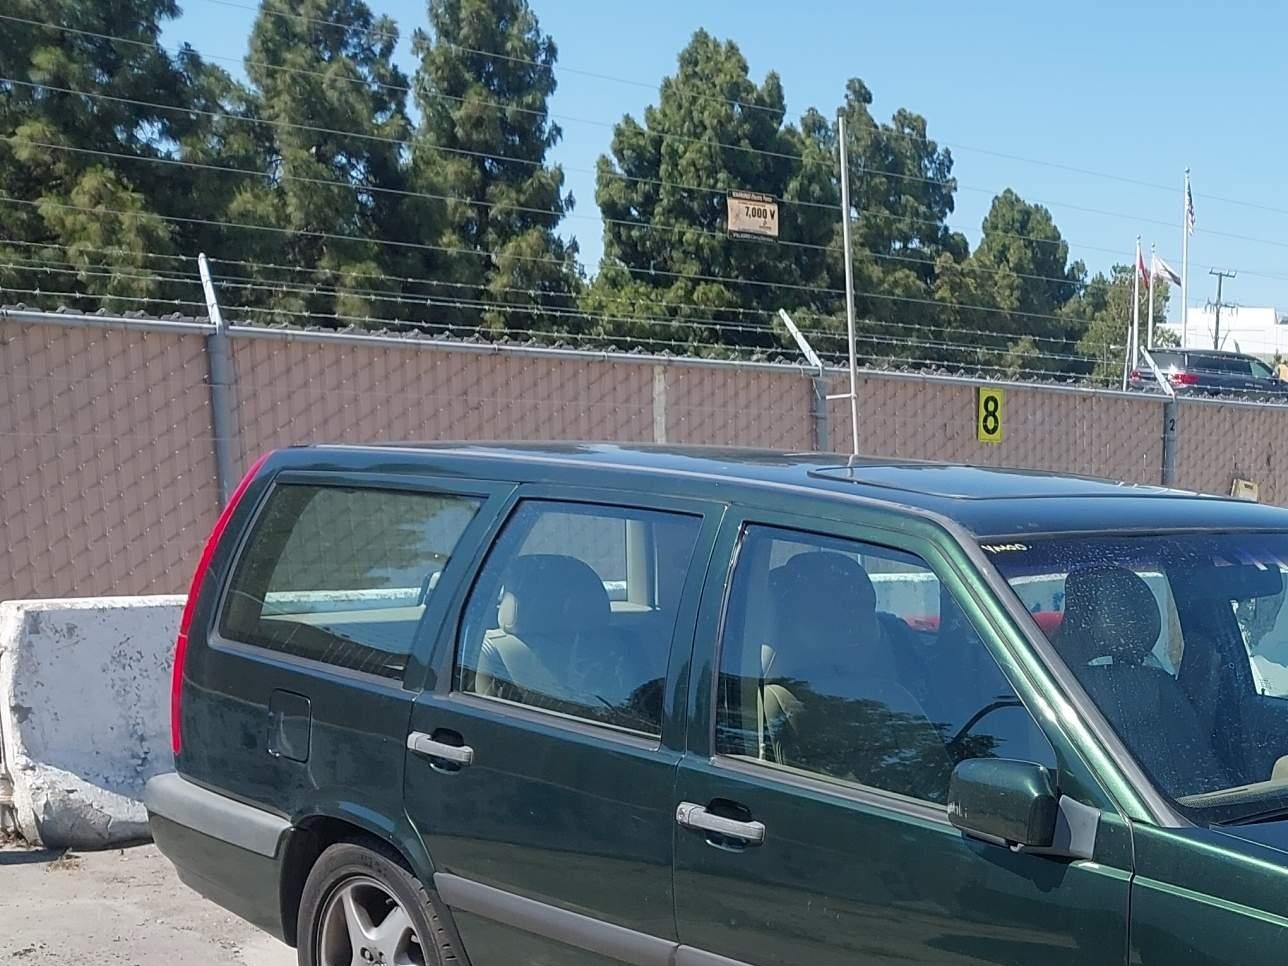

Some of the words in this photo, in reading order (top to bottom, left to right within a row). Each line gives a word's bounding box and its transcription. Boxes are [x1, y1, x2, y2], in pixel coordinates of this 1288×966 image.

[745, 206, 768, 219] 7,000
[769, 209, 776, 220] V
[982, 395, 999, 435] 8
[1169, 418, 1176, 431] 2
